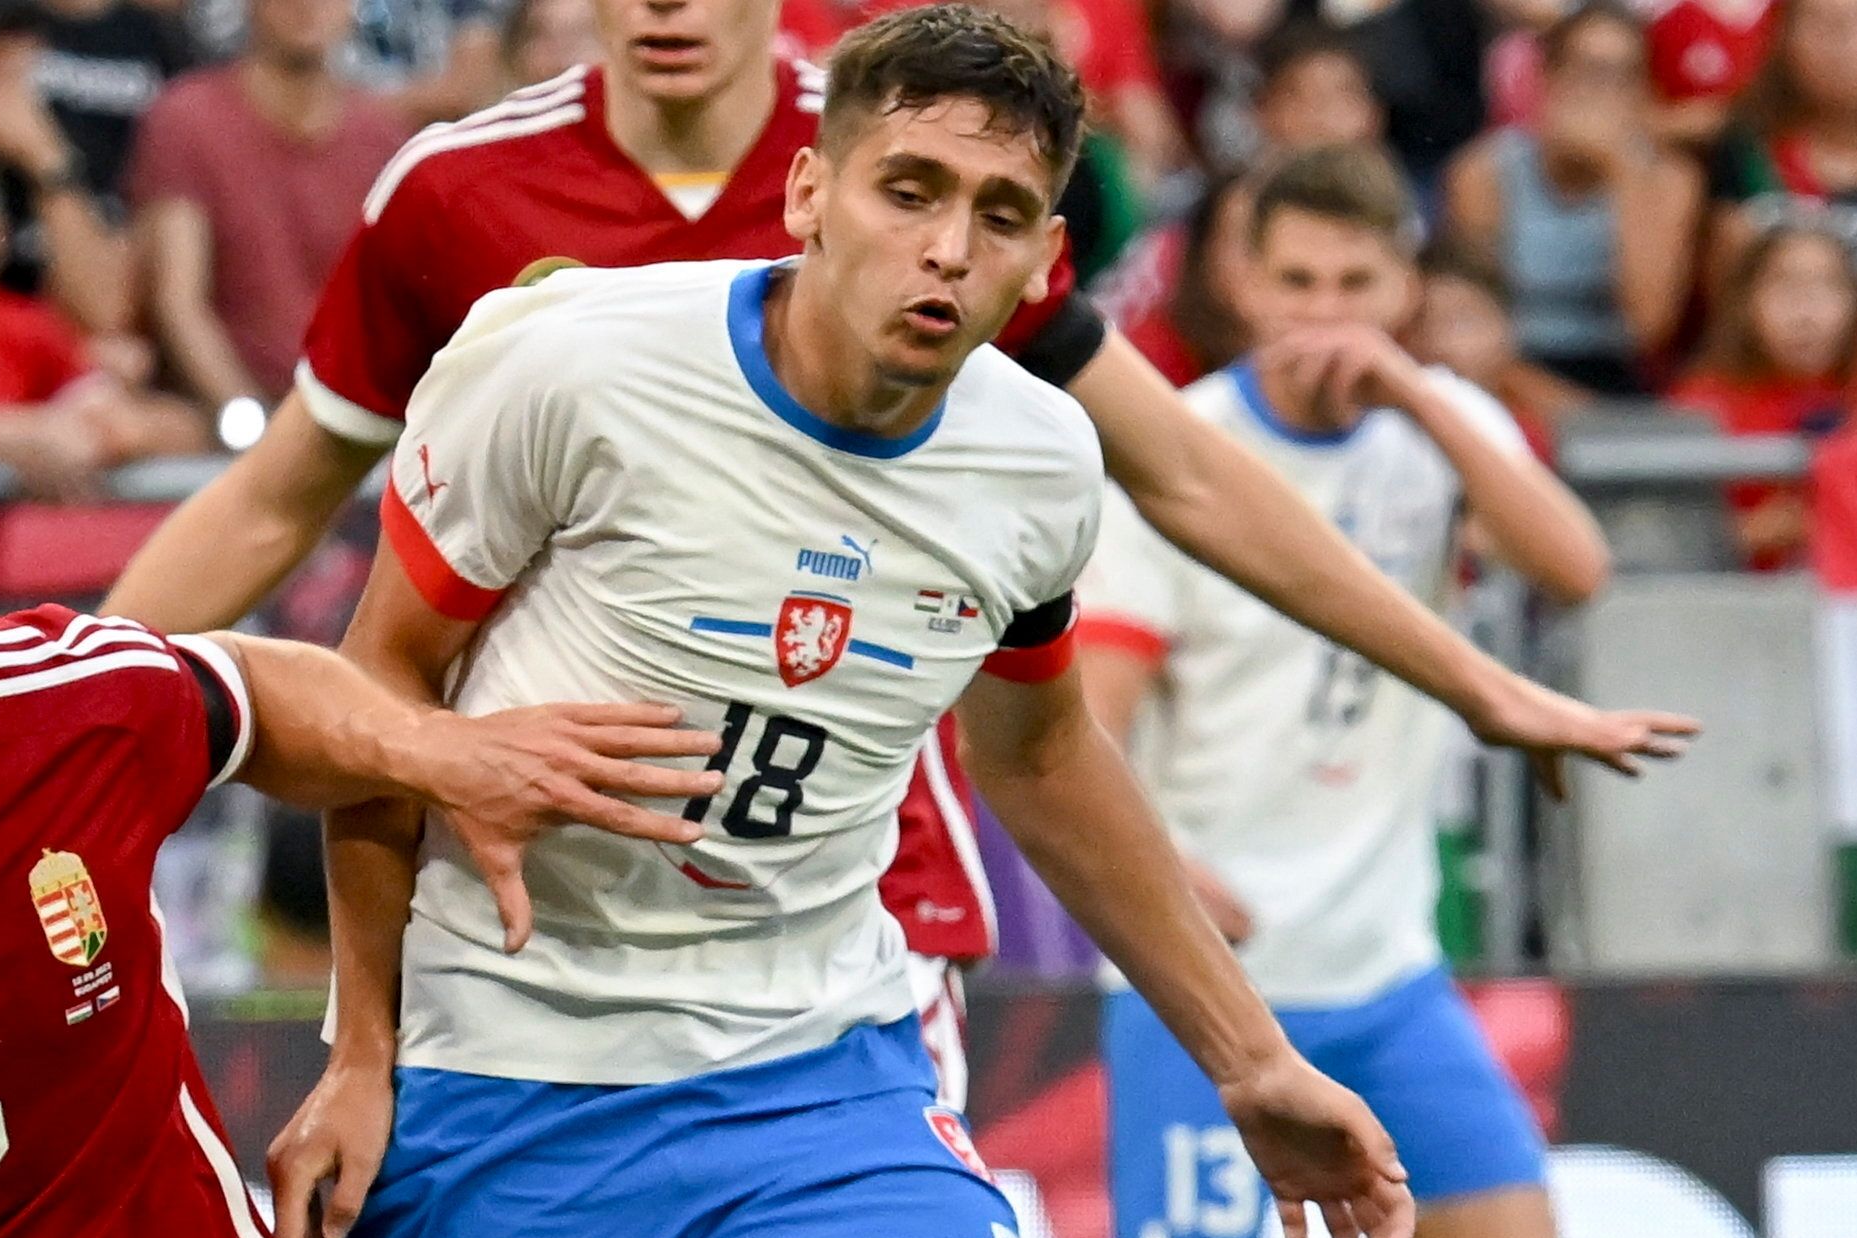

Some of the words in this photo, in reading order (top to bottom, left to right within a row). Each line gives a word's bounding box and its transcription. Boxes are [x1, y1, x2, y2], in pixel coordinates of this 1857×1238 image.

[795, 547, 863, 582] PUMA
[682, 701, 830, 840] 18
[1163, 1122, 1262, 1238] 13
